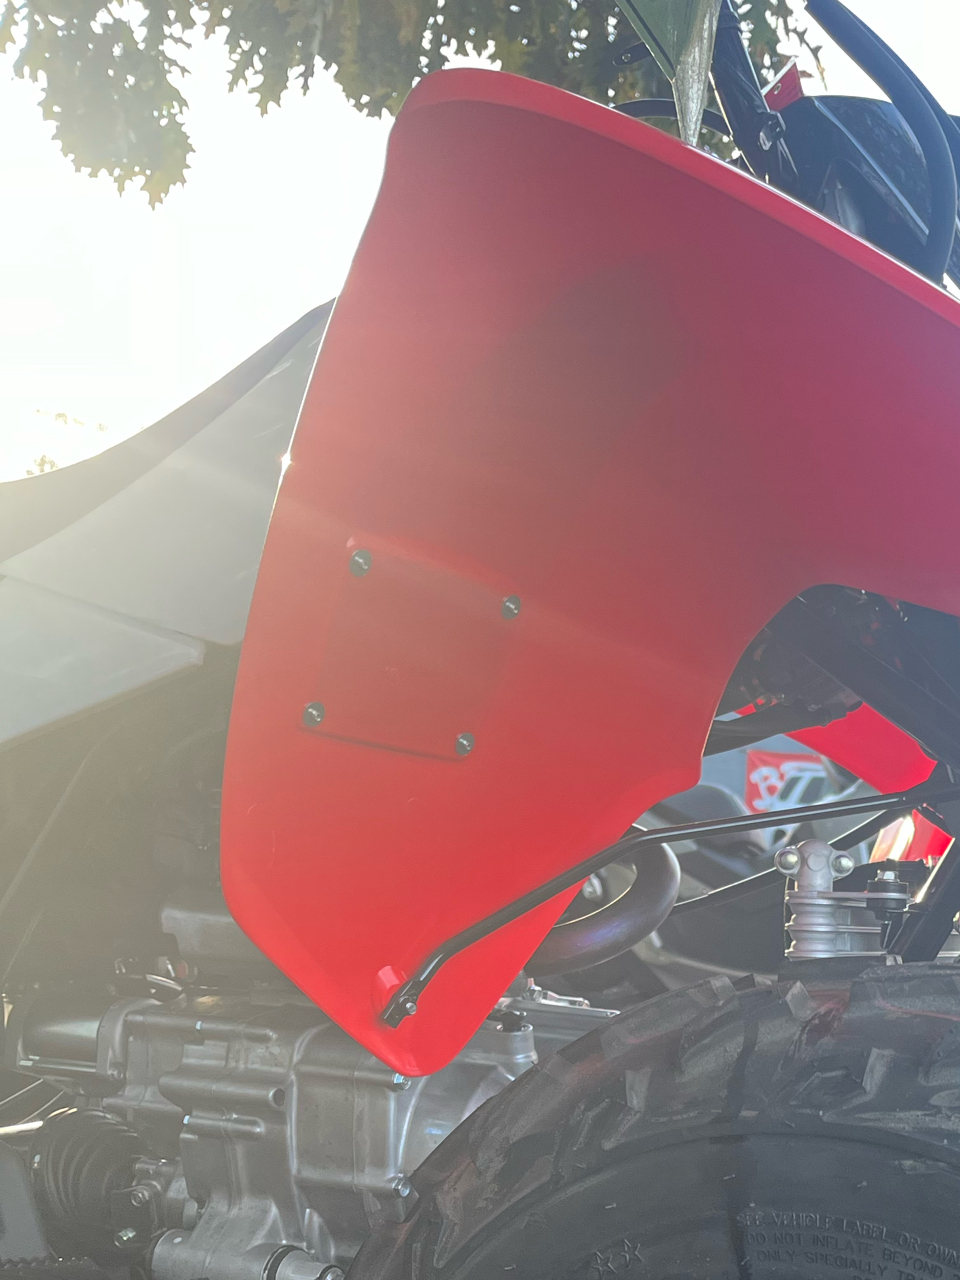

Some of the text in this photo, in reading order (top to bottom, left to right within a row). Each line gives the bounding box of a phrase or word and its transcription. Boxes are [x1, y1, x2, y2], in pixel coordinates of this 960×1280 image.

[772, 1212, 833, 1230] VEHICLE
[898, 1231, 921, 1252] OR
[756, 1250, 797, 1262] ONLY
[804, 1252, 887, 1279] SPECIALLY
[773, 1232, 806, 1245] NOT
[811, 1234, 874, 1257] INFLATE
[882, 1247, 944, 1280] BEYOND
